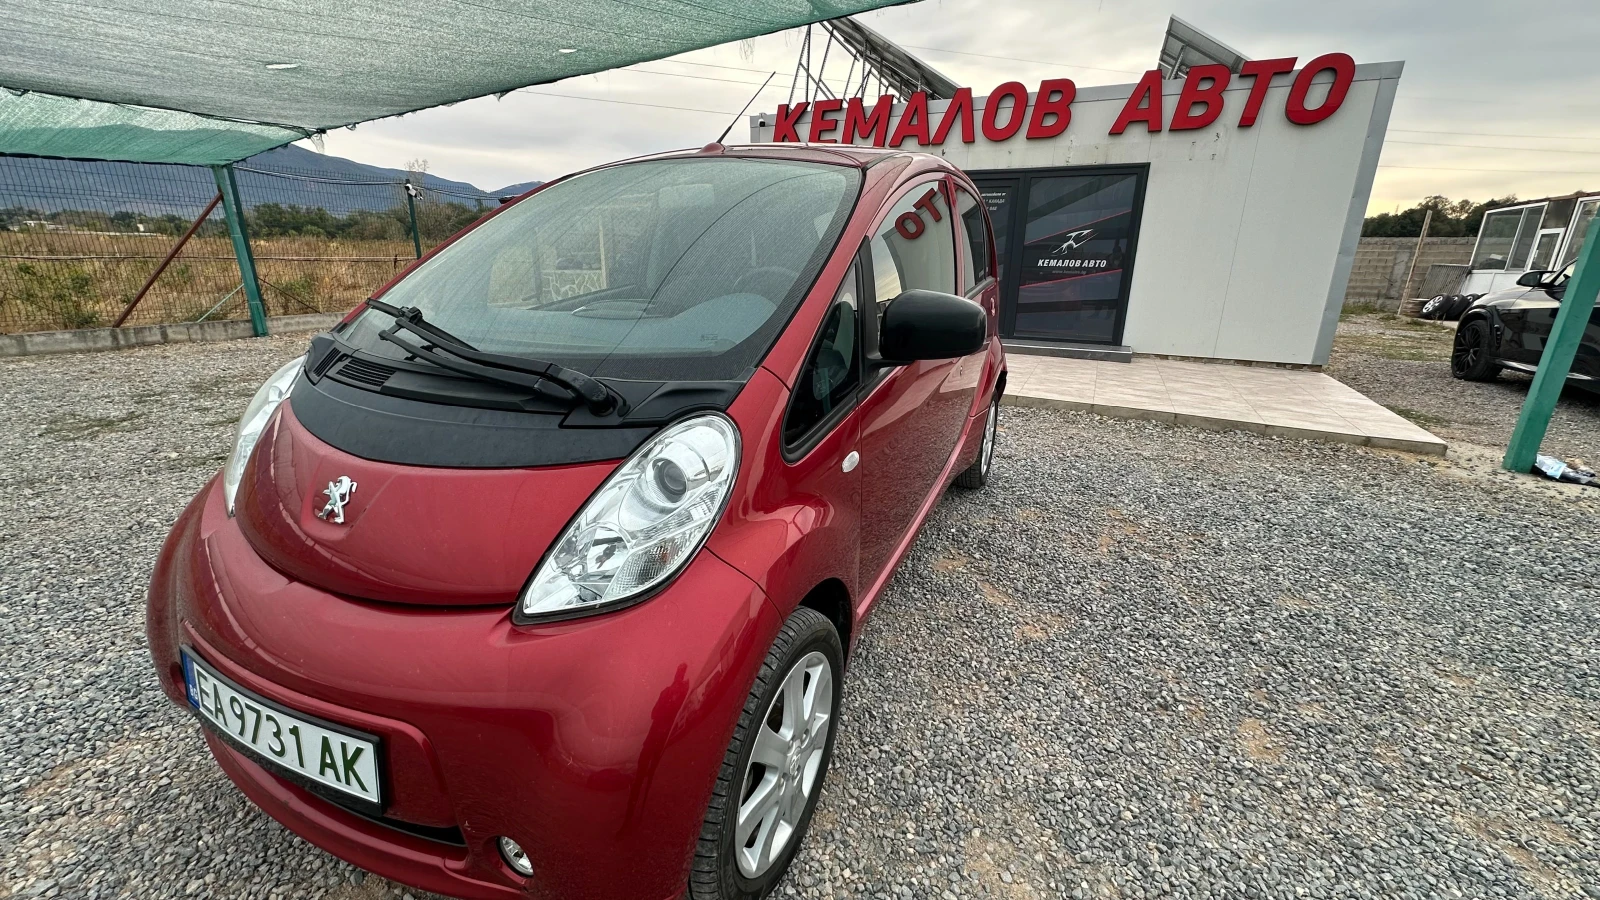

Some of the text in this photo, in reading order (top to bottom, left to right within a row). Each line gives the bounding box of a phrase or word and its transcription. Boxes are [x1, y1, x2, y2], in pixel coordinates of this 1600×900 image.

[773, 52, 1356, 148] КЕМАЛОВ АВТО
[1037, 259, 1107, 268] КЕМАЛОВ АВТО
[319, 734, 369, 793] AK
